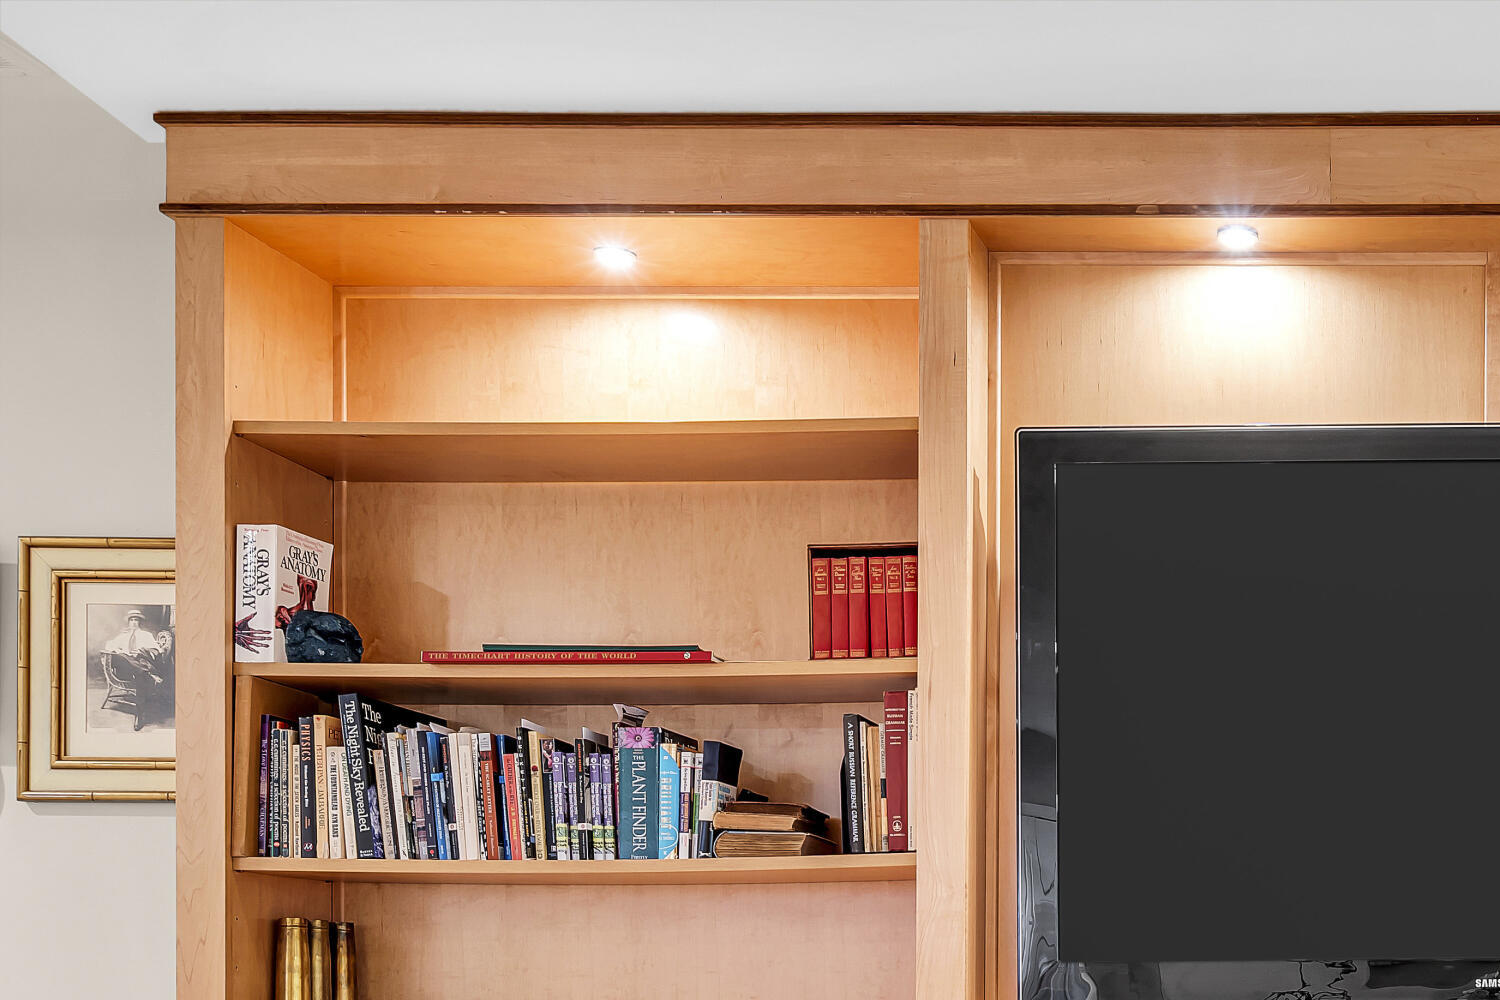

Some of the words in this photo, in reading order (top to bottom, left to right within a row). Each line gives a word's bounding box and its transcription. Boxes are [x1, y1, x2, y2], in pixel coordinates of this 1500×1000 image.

[280, 556, 327, 583] ANATOMY
[288, 545, 319, 567] GRAY'S
[257, 548, 271, 597] GRAY'S
[344, 701, 356, 724] The
[361, 702, 382, 725] The
[301, 724, 311, 761] PHYSICS
[347, 724, 361, 758] Night
[847, 729, 855, 750] SHORT
[340, 752, 348, 762] ON
[350, 757, 363, 781] Sky
[848, 751, 856, 777] RUSSIAN
[341, 762, 349, 783] DEATH
[632, 761, 647, 804] PLANT
[354, 781, 370, 832] Revealed
[850, 778, 858, 810] REFERENCE
[632, 805, 648, 852] FINDER
[851, 810, 859, 843] GRAMMAR
